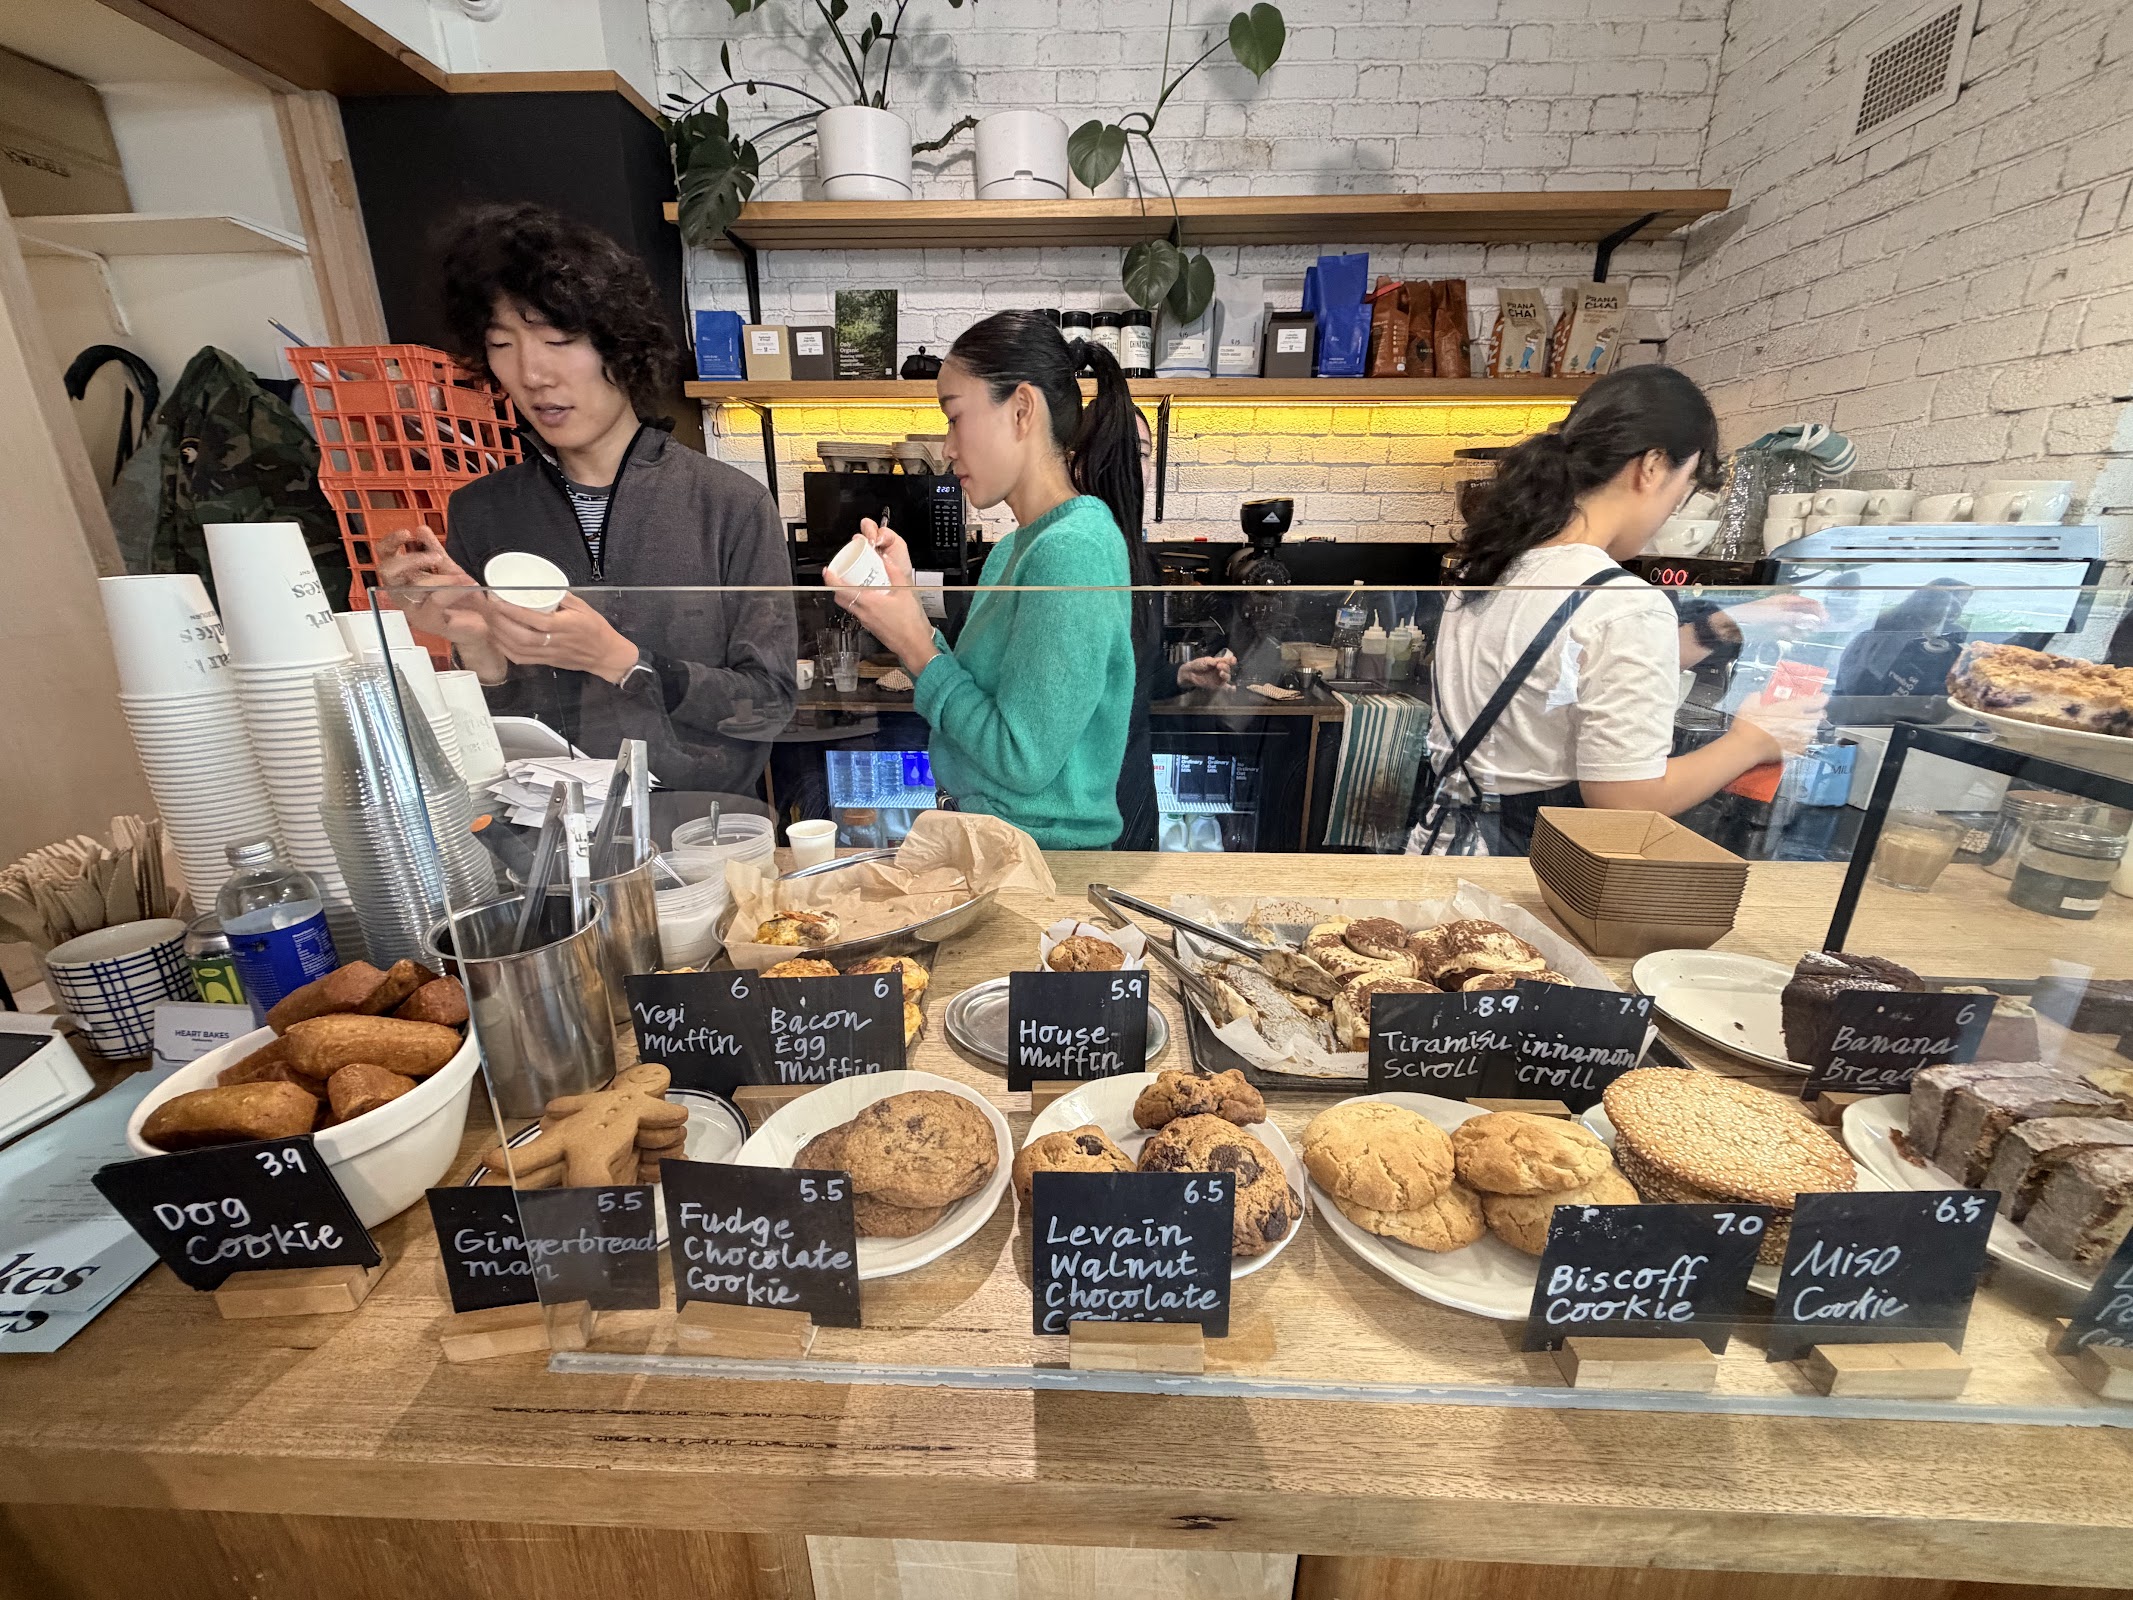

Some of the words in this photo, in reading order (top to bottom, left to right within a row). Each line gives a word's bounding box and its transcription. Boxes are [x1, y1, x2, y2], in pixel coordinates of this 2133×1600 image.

[1508, 308, 1536, 318] CHAI
[1584, 302, 1618, 310] CHAI
[730, 976, 749, 999] 6
[874, 978, 889, 998] 6
[1110, 978, 1142, 1000] 5.9
[634, 1002, 685, 1032] Vegi
[1478, 994, 1520, 1018] 8.9
[1618, 997, 1650, 1018] 7.9
[1955, 1004, 1977, 1025] 6
[174, 1030, 202, 1038] HEART
[203, 1030, 230, 1039] BAKES
[770, 1006, 873, 1035] Bacon
[1018, 1019, 1111, 1046] House
[774, 1033, 826, 1061] Egg
[1378, 1030, 1513, 1054] Tiramisu
[1521, 1032, 1636, 1069] innamon
[1830, 1024, 1959, 1056] Banana
[1384, 1056, 1479, 1080] Scroll
[1517, 1063, 1596, 1090] croll
[254, 1148, 307, 1177] 3.9
[596, 1191, 644, 1213] 5.5
[800, 1178, 845, 1203] 5.5
[1183, 1179, 1224, 1204] 6.5
[153, 1198, 251, 1232] Dog
[1712, 1212, 1764, 1236] 7.0
[1935, 1196, 1986, 1224] 6.5
[680, 1202, 795, 1248] Fudge
[1046, 1215, 1193, 1248] Levain
[186, 1222, 344, 1266] Cookie
[454, 1228, 658, 1263] Gingerbread
[684, 1236, 853, 1270] Chocolate
[461, 1259, 560, 1281] man
[1050, 1250, 1199, 1284] Walnut
[1790, 1240, 1902, 1278] Miso
[686, 1266, 800, 1306] Cookie
[1546, 1254, 1710, 1300] Biscoff
[1044, 1278, 1221, 1311] Chocolate
[1792, 1286, 1910, 1322] Cookie
[1546, 1294, 1696, 1326] Cookie
